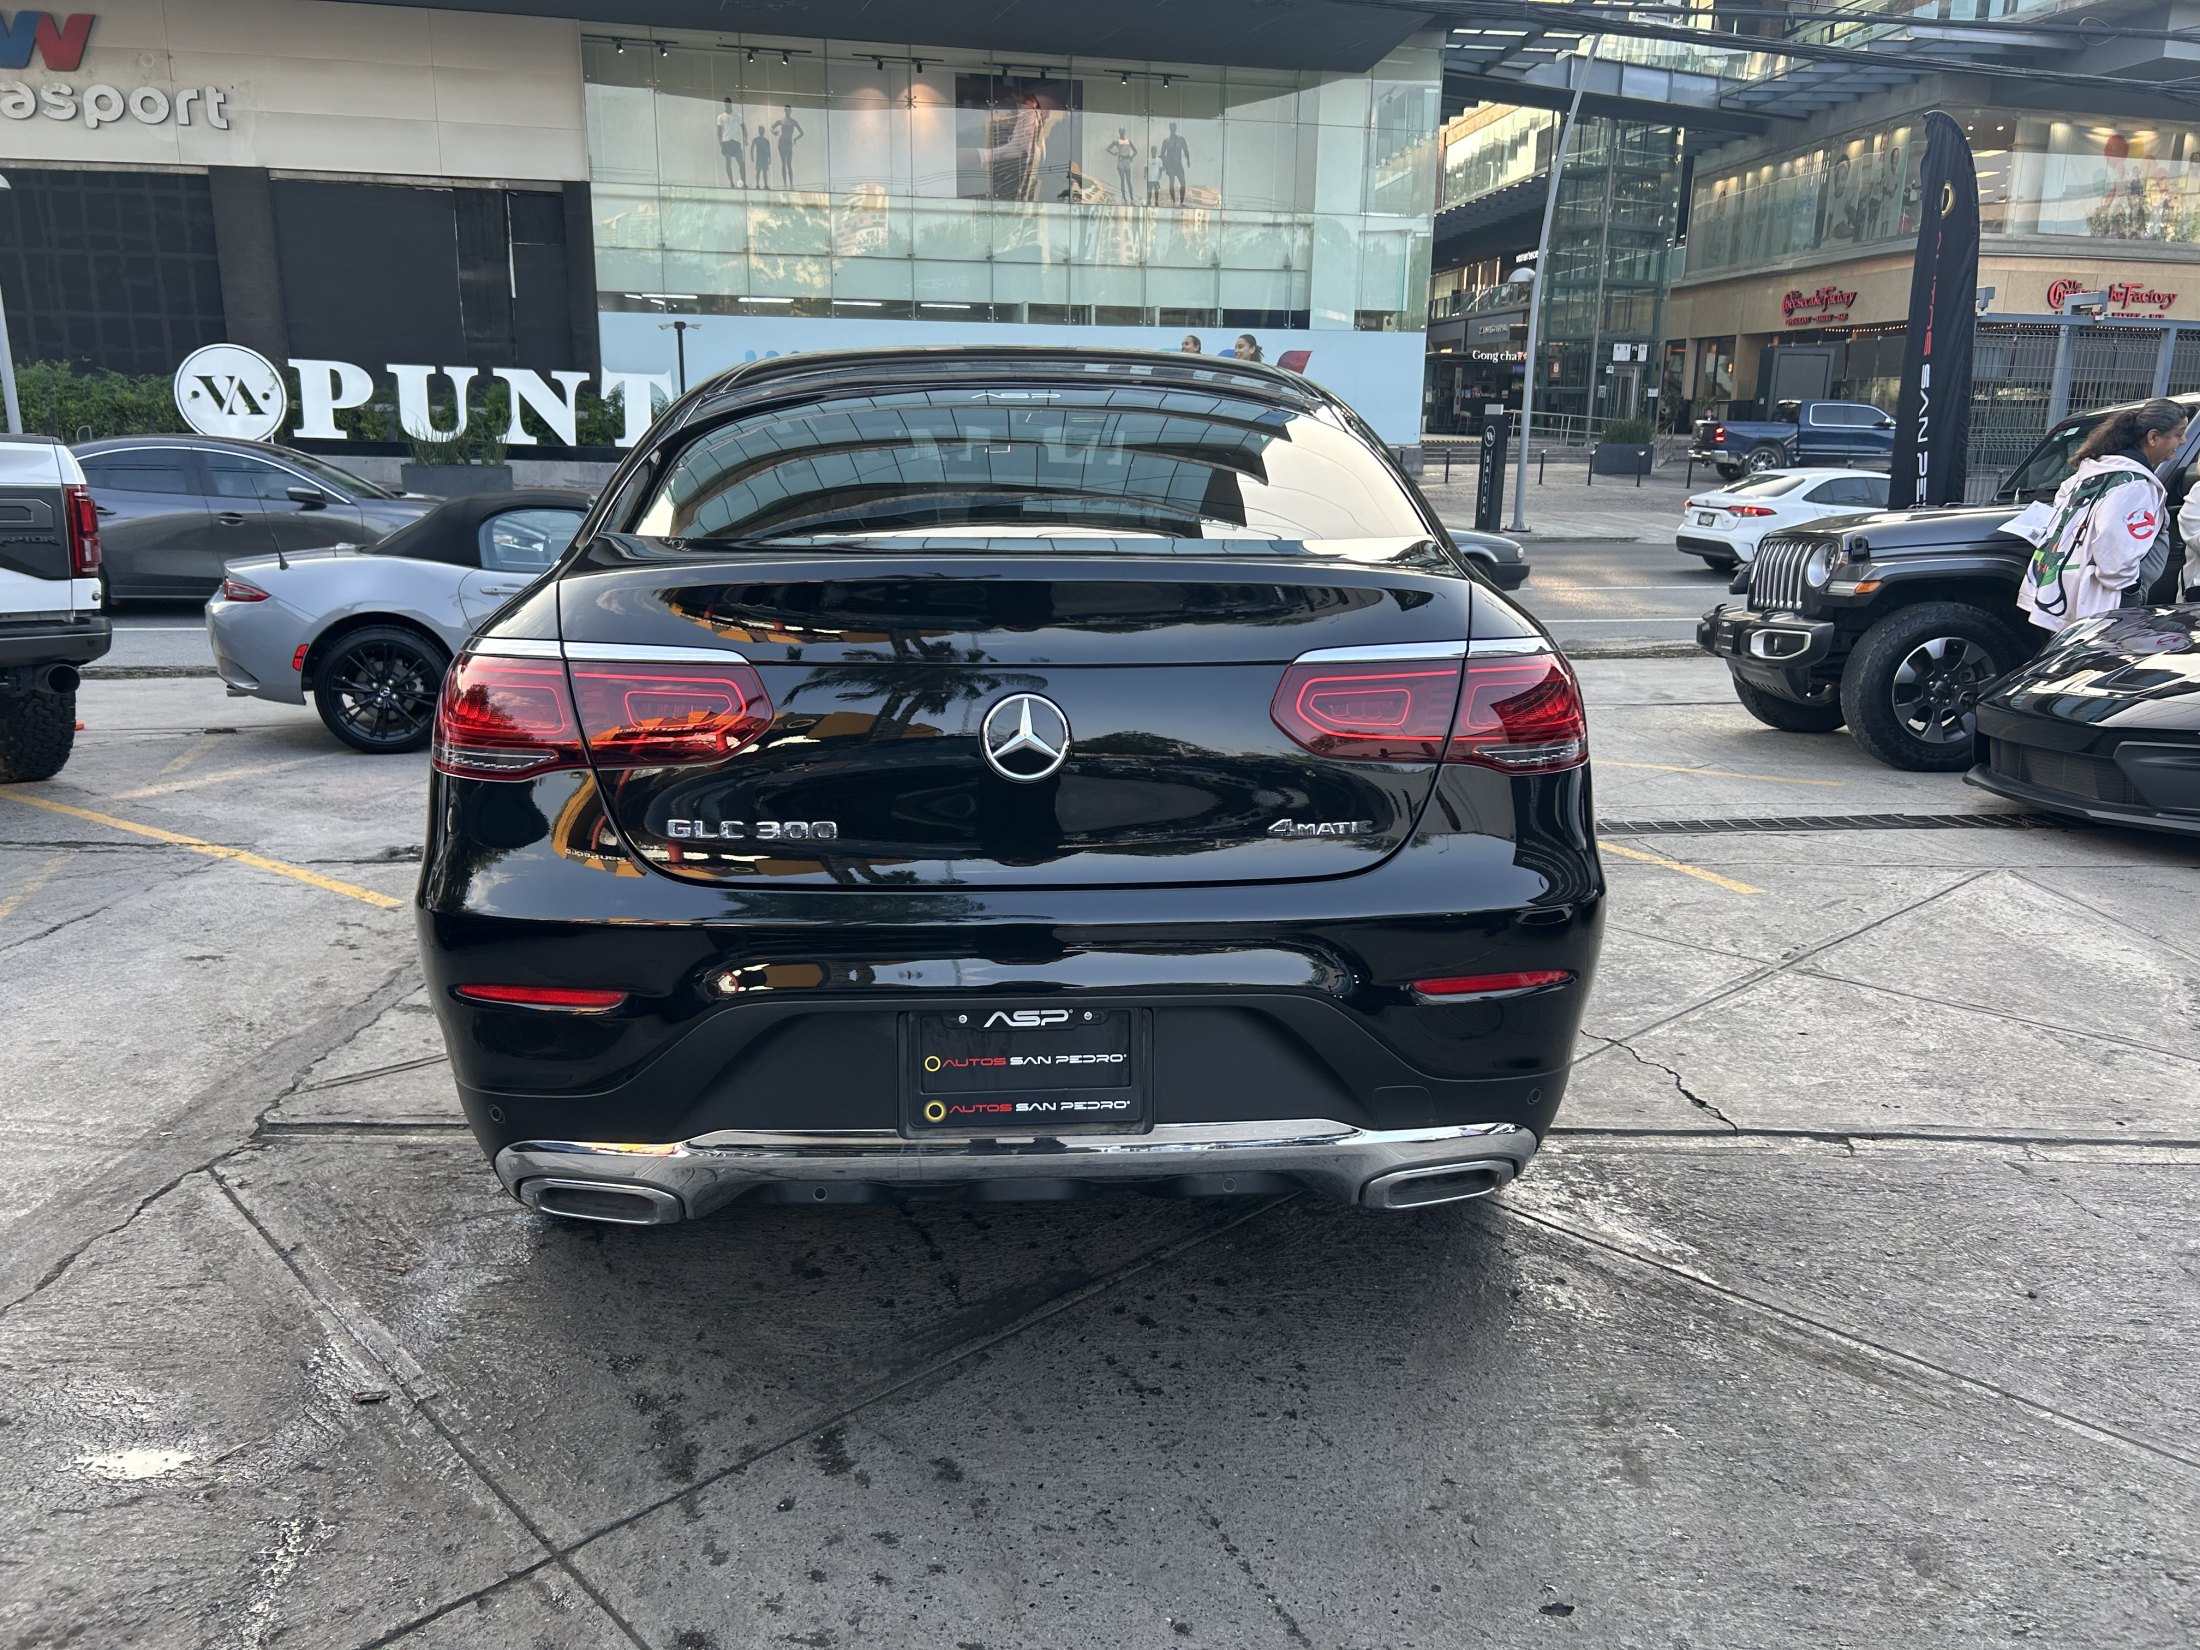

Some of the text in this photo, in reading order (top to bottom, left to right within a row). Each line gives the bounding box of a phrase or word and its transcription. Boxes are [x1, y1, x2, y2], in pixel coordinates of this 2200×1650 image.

[1820, 286, 1857, 312] Factory
[2119, 283, 2178, 310] Factory
[1472, 350, 1499, 363] Gong
[1500, 351, 1518, 361] cha
[1917, 363, 1931, 443] SAN
[1916, 450, 1928, 509] PE
[667, 819, 838, 839] GLC 300
[984, 1009, 1069, 1028] ASP
[942, 1053, 1123, 1068] AUTOS SAN PEDRO
[949, 1100, 1127, 1114] AUTOS SAN PEDRO
